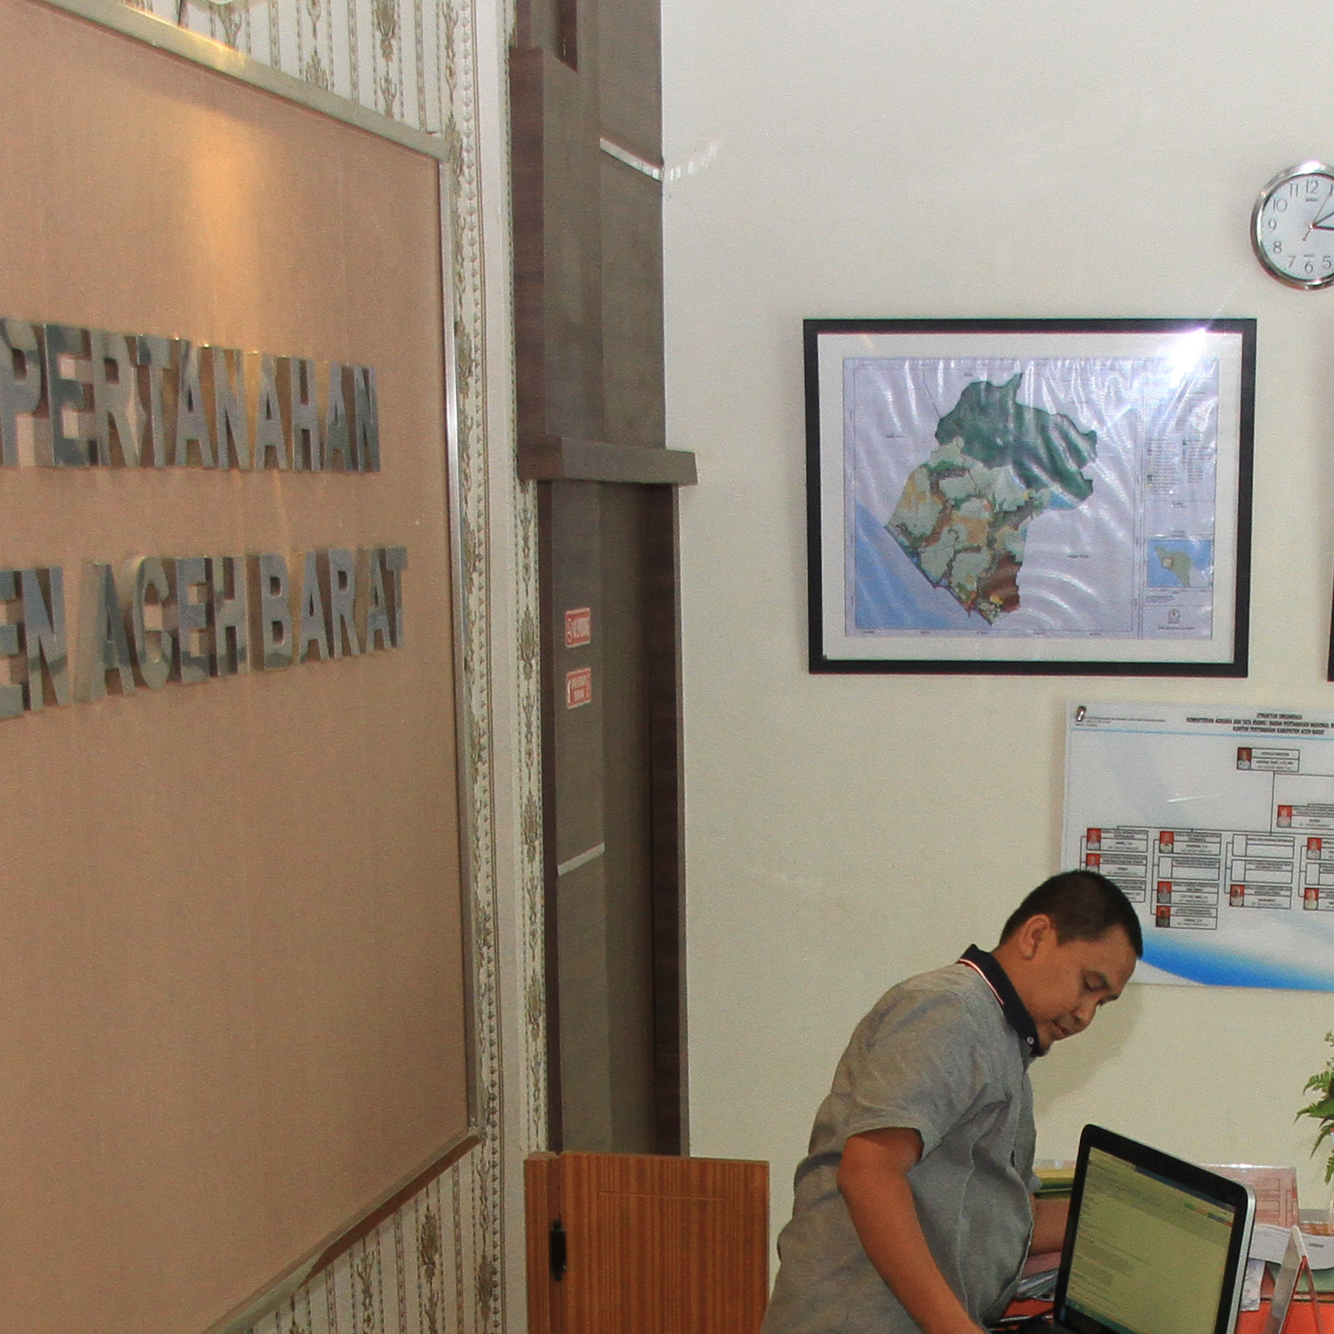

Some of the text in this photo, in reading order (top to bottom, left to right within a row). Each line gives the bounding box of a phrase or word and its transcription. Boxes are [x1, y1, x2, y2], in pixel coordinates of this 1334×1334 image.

[1289, 183, 1299, 197] 11
[1306, 180, 1319, 194] 12
[1273, 199, 1288, 213] 10
[1268, 219, 1277, 232] 9
[1273, 241, 1282, 254] 8
[1287, 255, 1296, 268] 7
[1304, 261, 1313, 273] 6
[1322, 256, 1332, 269] 5
[79, 555, 247, 703] ACEH
[253, 546, 408, 671] BARAT
